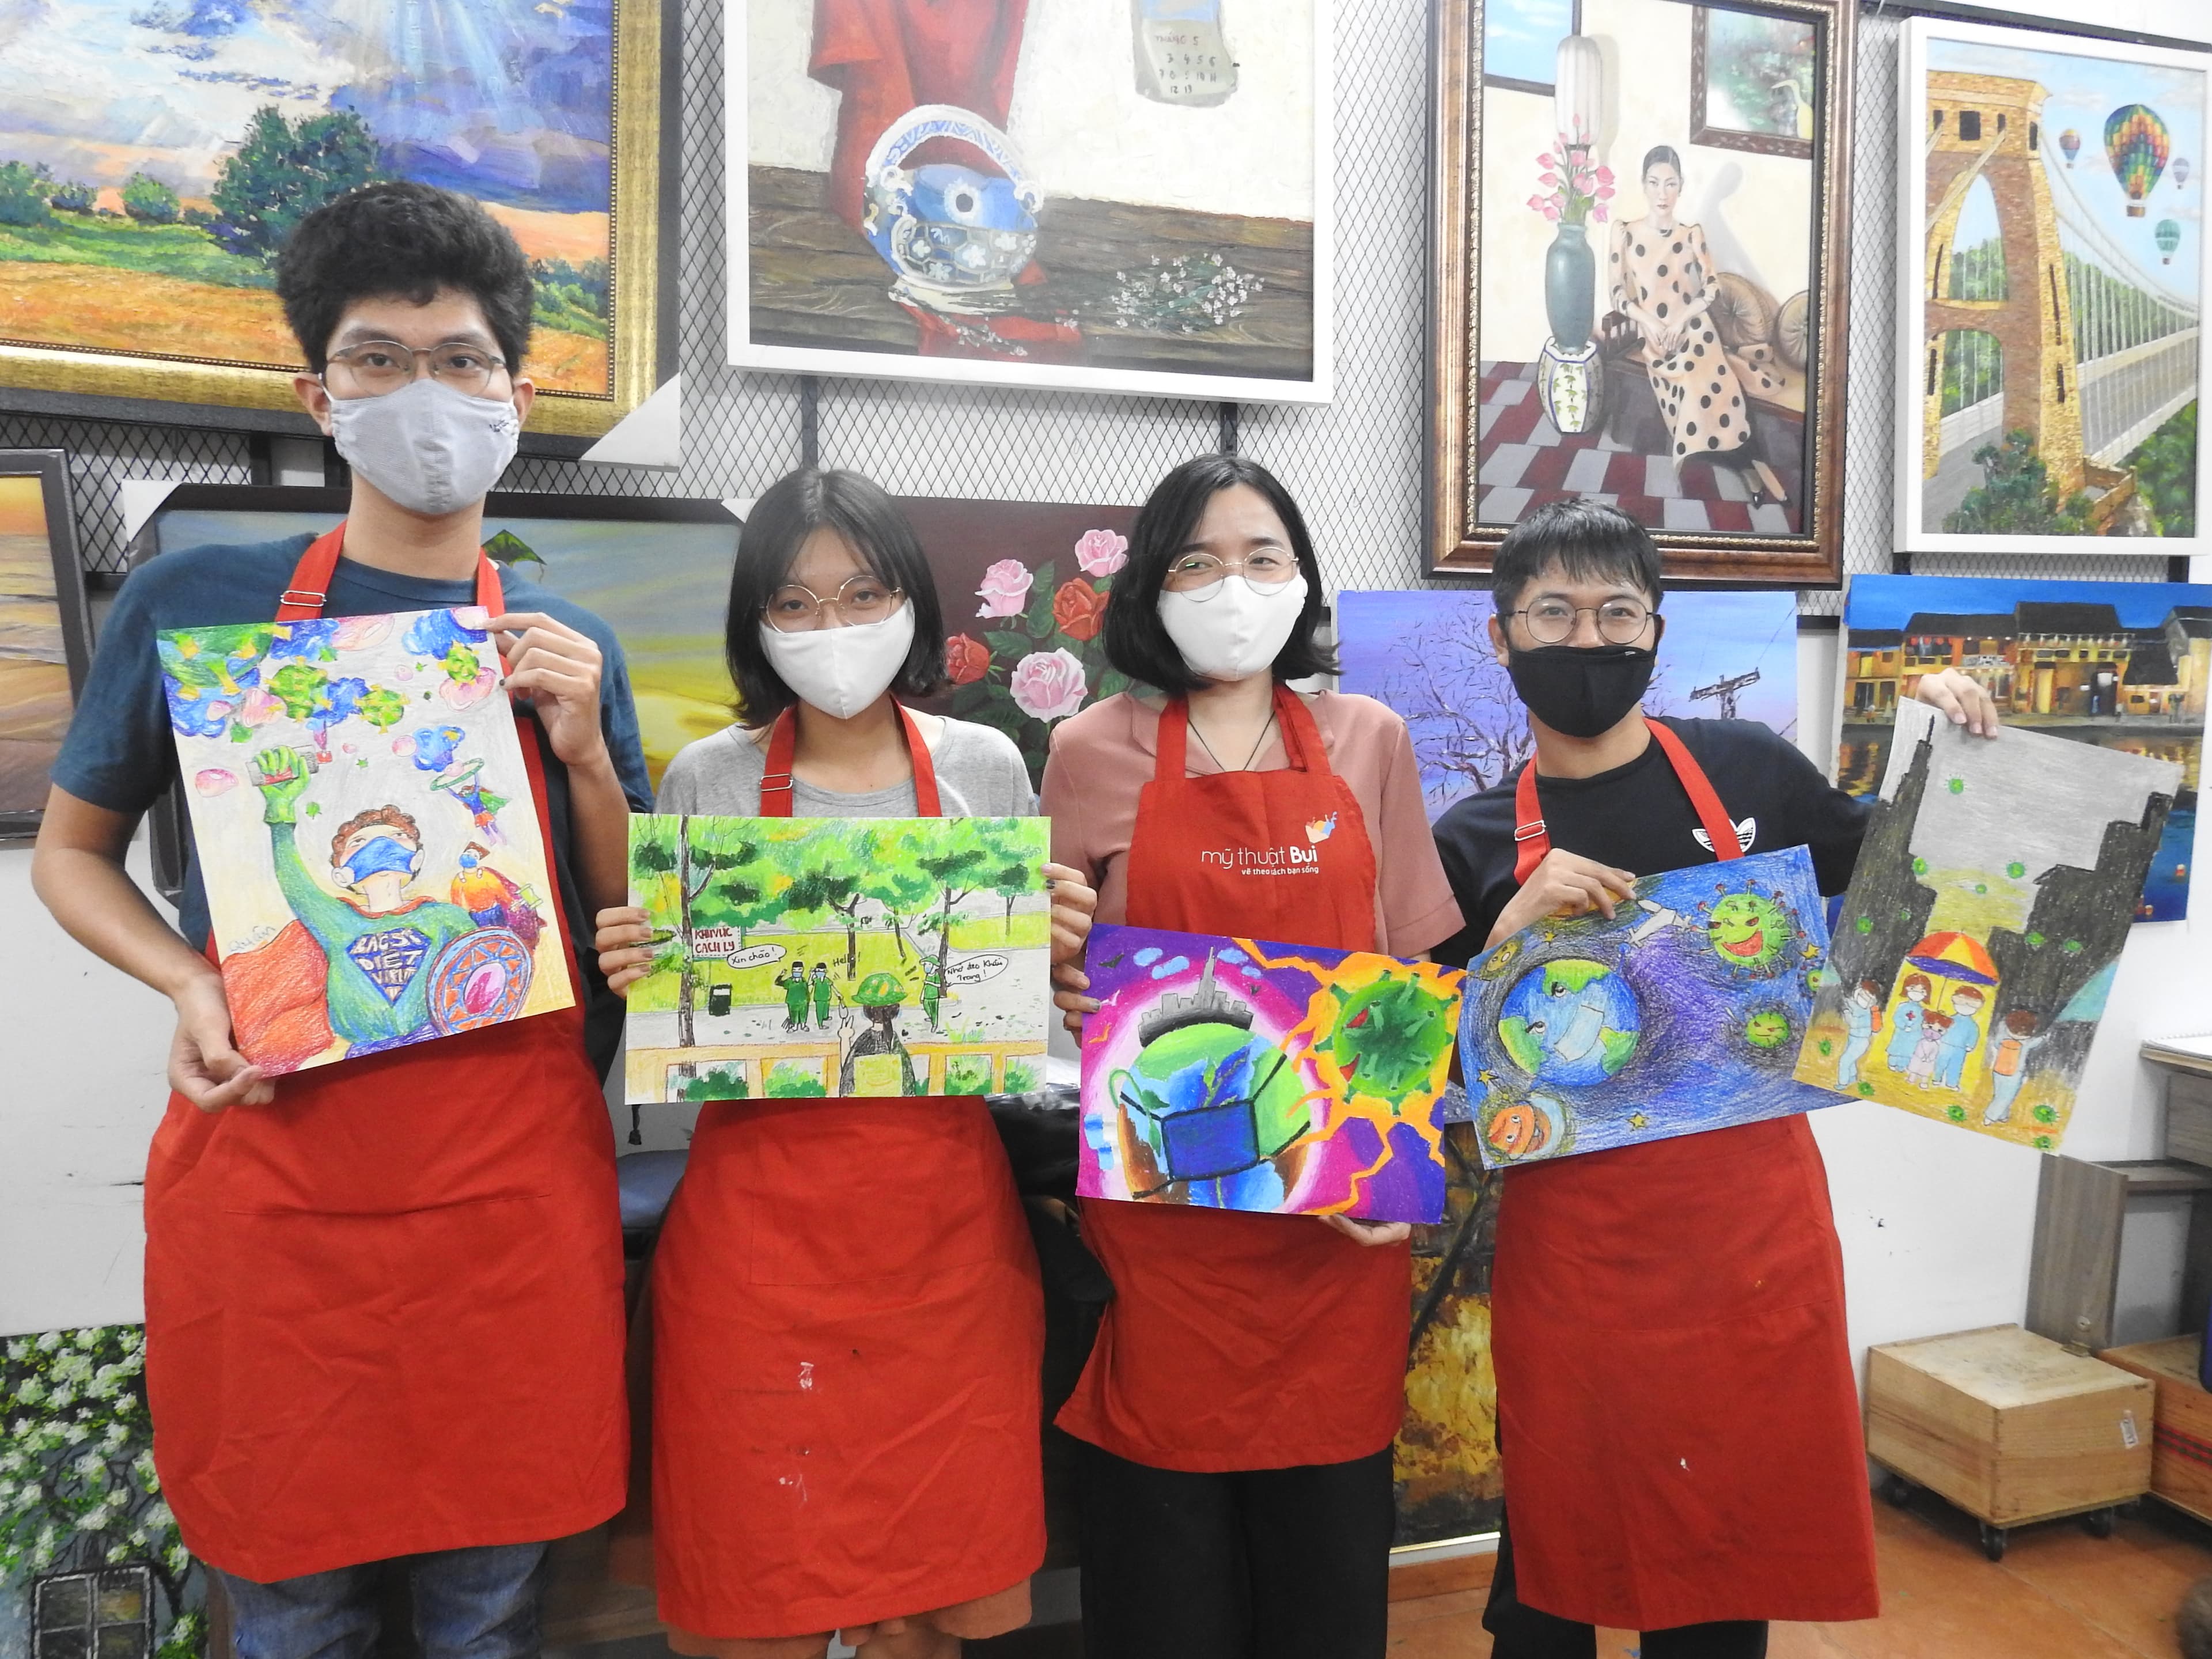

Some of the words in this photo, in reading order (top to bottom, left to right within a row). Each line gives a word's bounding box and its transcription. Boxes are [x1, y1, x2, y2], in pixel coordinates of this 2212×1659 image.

[1166, 53, 1173, 63] 3
[1184, 54, 1190, 65] 4
[1197, 55, 1203, 65] 5
[1159, 69, 1164, 79] 7
[1170, 85, 1179, 94] 12
[1184, 84, 1192, 93] 13
[1201, 849, 1233, 869] mỹ
[1237, 847, 1286, 867] thuật
[1287, 867, 1300, 875] bạn
[723, 941, 735, 952] LY
